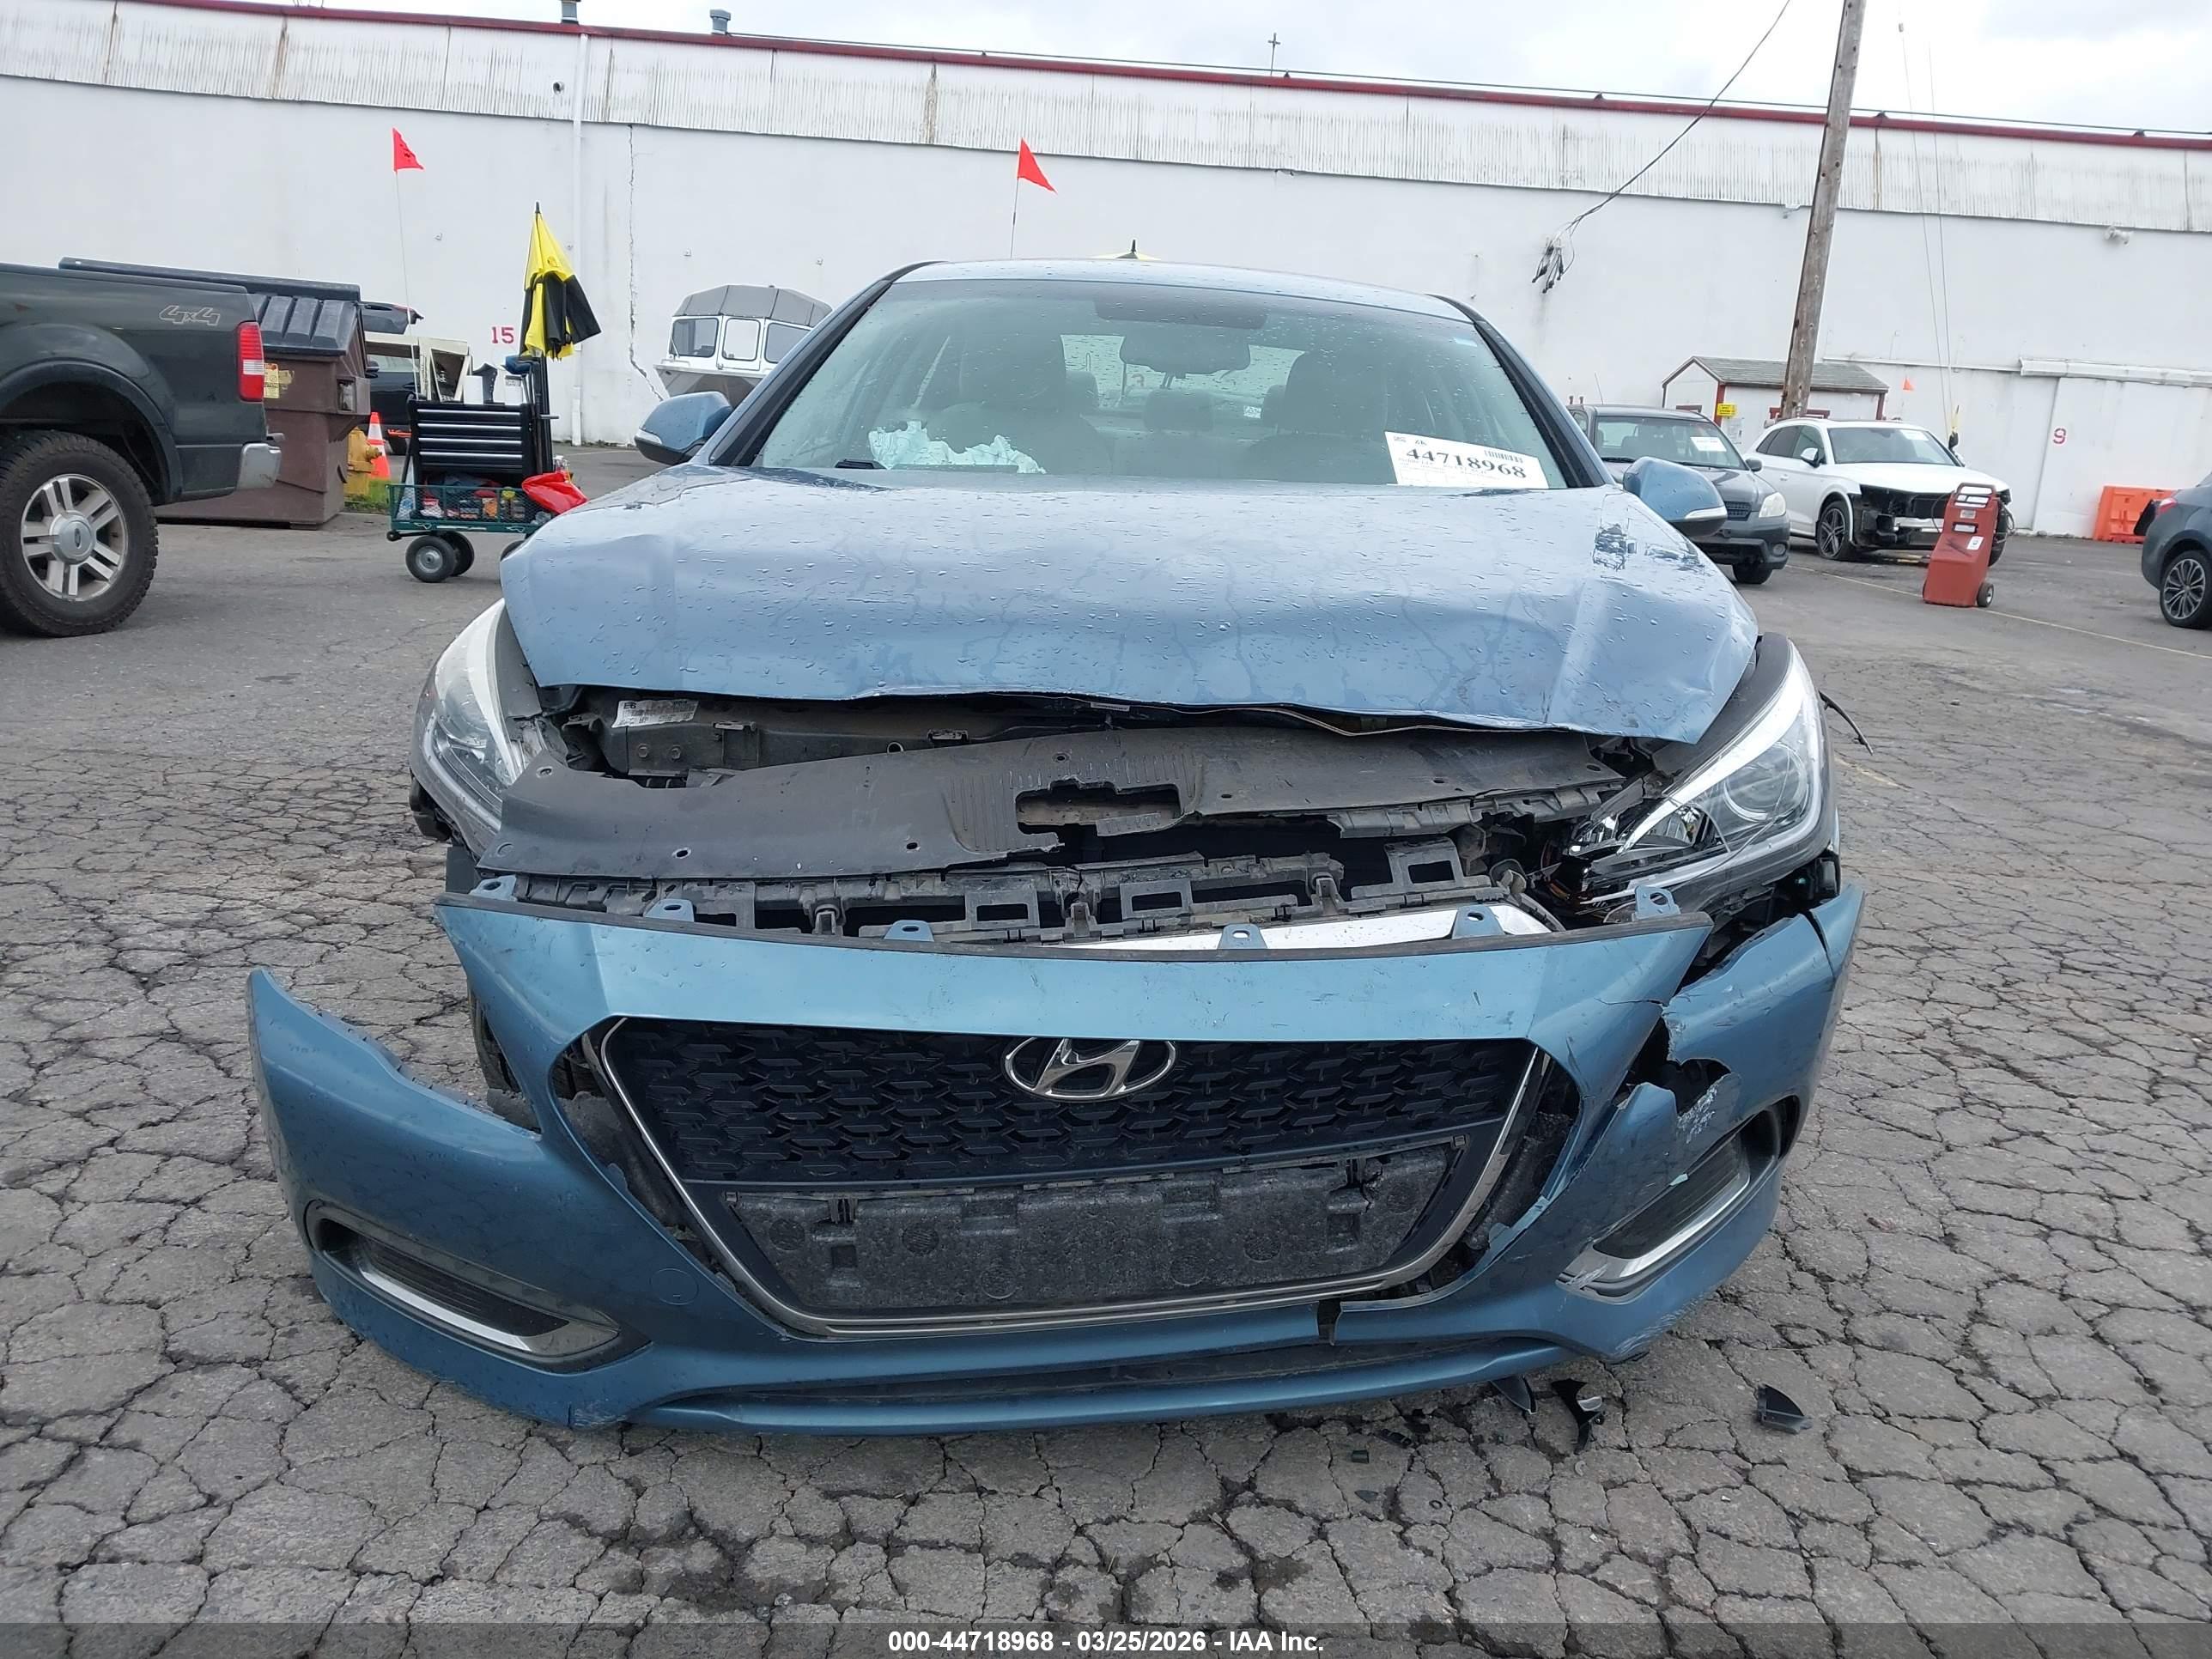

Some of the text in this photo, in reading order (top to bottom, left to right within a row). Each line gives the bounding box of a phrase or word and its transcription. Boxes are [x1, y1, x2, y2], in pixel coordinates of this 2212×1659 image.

[158, 305, 221, 326] 4x4
[491, 326, 514, 344] 15
[2052, 428, 2067, 445] 9
[1406, 448, 1527, 478] 44718968
